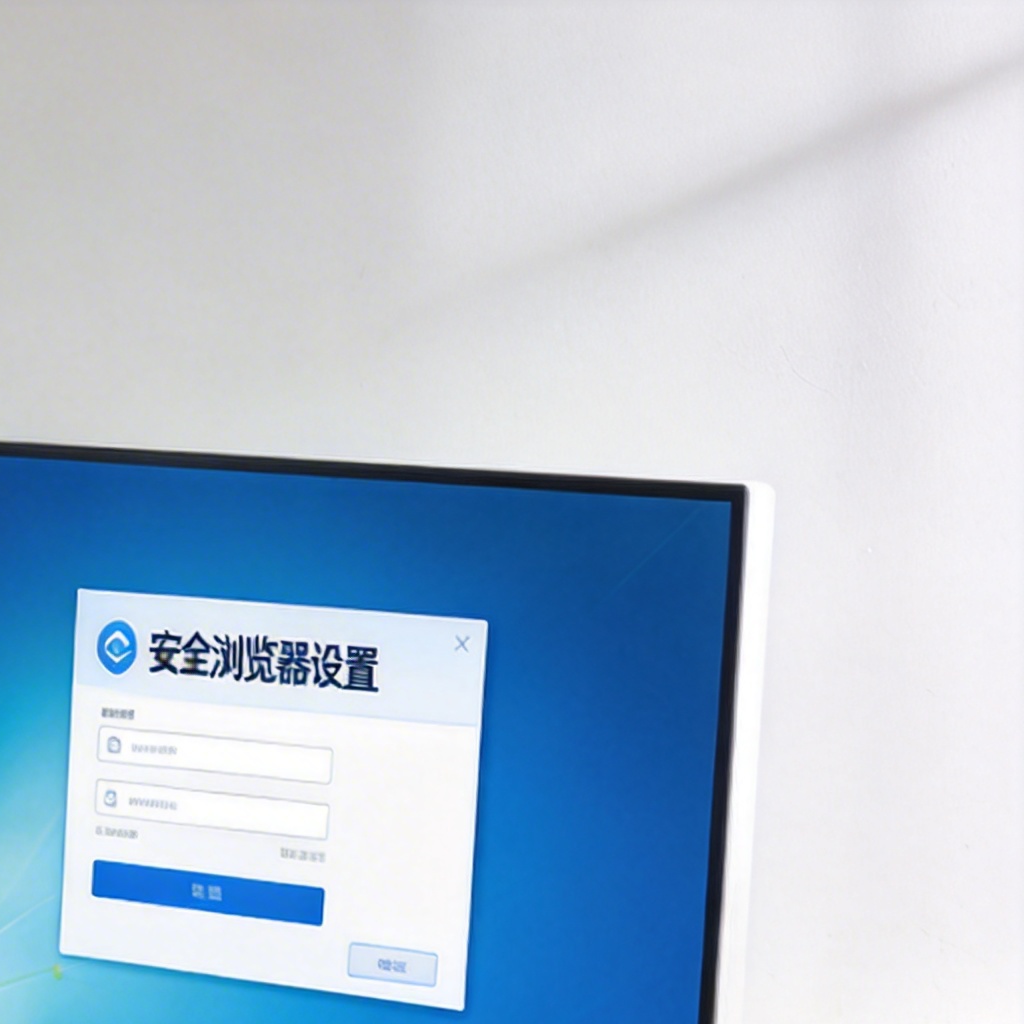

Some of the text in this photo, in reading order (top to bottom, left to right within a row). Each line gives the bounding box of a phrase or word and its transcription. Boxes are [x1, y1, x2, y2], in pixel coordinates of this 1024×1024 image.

[149, 631, 378, 692] 安全浏览器设置
